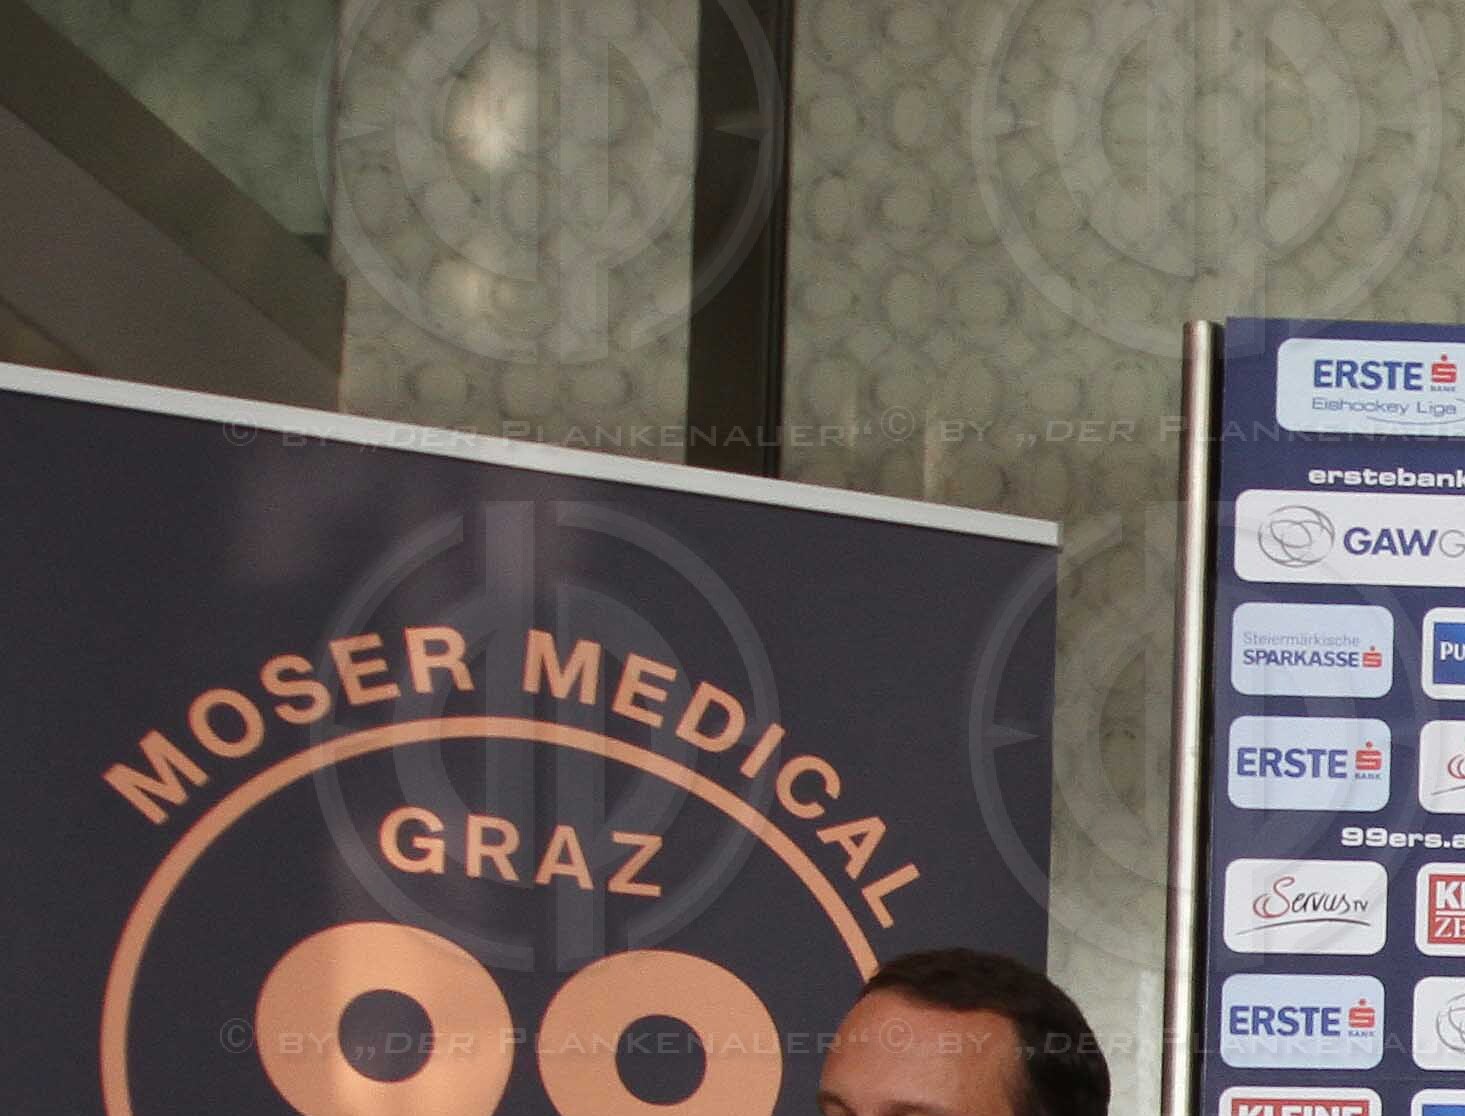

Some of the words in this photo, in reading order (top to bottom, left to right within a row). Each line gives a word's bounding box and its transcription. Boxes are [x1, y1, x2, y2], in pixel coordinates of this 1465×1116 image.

[1314, 360, 1423, 391] ERSTE
[1312, 397, 1409, 416] Eishockey
[1417, 400, 1457, 417] Liga
[1243, 631, 1361, 647] Steiermärkische
[1243, 648, 1360, 668] SPARKASSE
[102, 626, 474, 825] MOSER
[522, 629, 922, 928] MEDICAL
[1237, 747, 1348, 778] ERSTE
[378, 805, 664, 897] GRAZ
[1229, 1005, 1341, 1037] ERSTE
